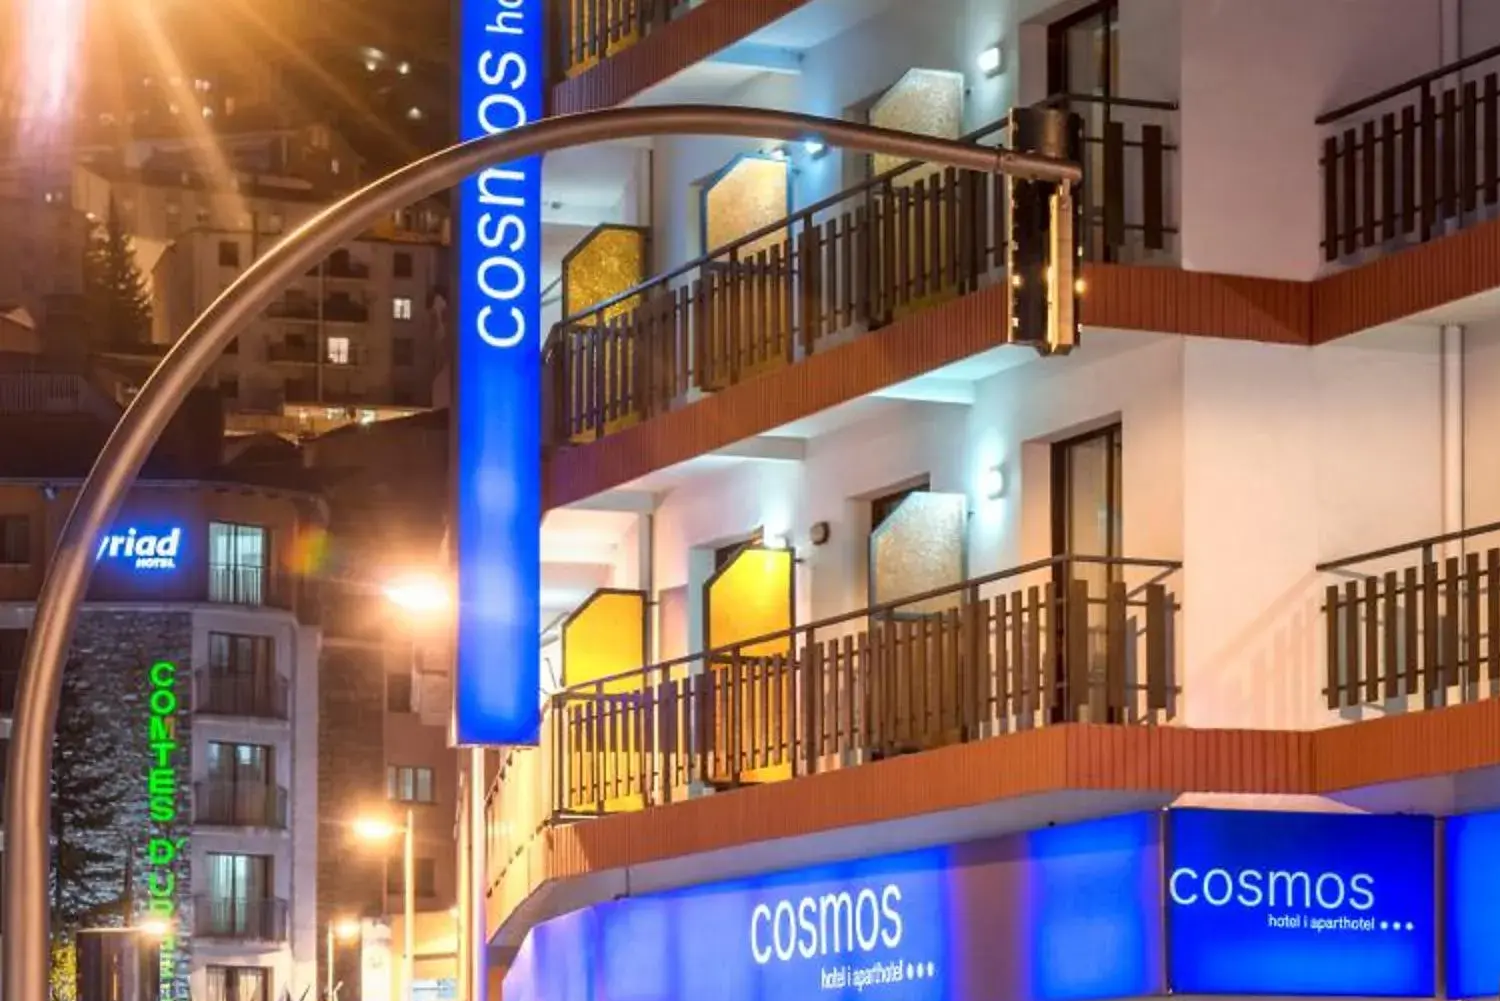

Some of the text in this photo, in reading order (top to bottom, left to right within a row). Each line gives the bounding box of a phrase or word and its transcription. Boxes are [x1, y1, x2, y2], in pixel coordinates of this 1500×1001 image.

[485, 0, 524, 35] ho
[95, 527, 181, 563] yriad
[149, 661, 177, 822] CONTES
[1169, 867, 1375, 911] cosmos
[751, 883, 903, 965] cosmos
[1267, 913, 1301, 929] hotel
[1310, 916, 1376, 934] aparthotel
[821, 966, 846, 990] hotel
[852, 959, 903, 992] aparthotel
